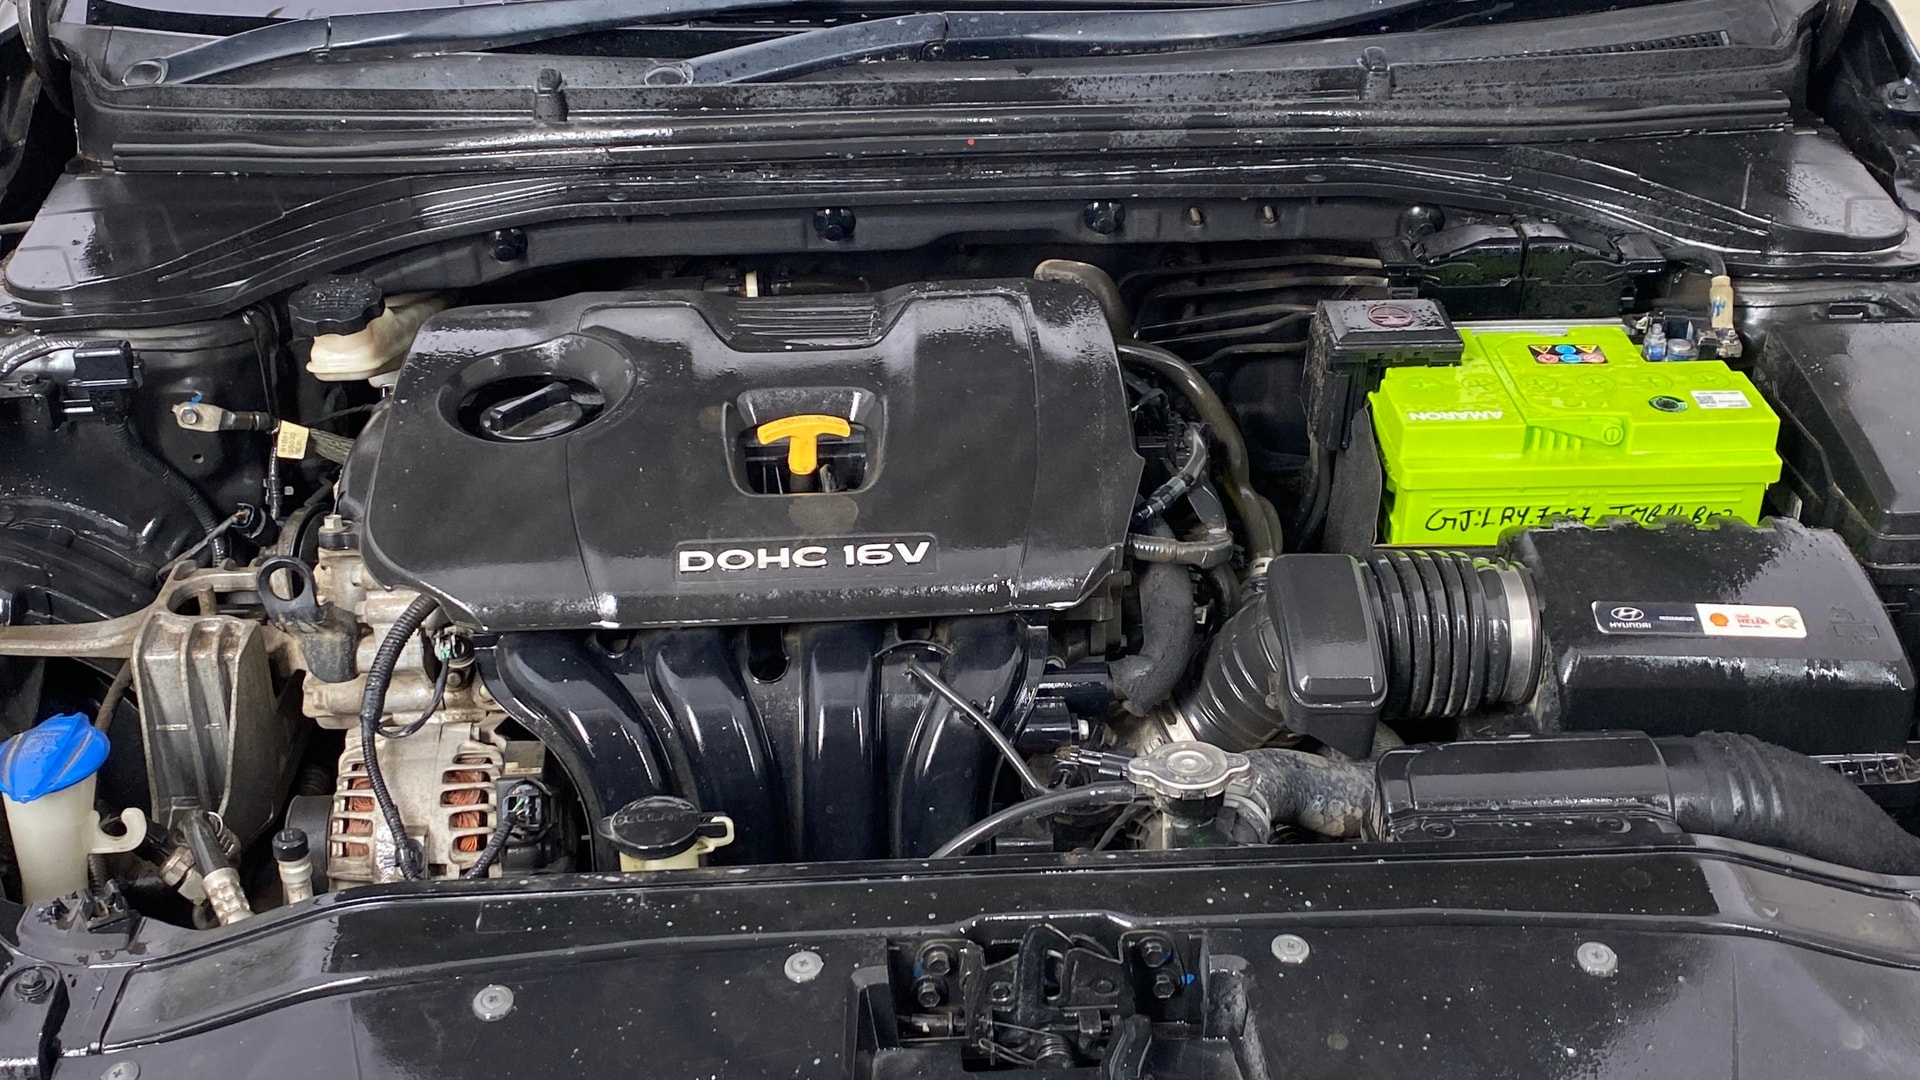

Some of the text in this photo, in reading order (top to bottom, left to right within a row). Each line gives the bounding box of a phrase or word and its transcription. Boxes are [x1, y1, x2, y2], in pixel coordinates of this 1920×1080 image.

[1408, 410, 1503, 421] AMARON
[678, 541, 931, 573] DOHC 16V
[1609, 621, 1652, 629] HYUNDAI
